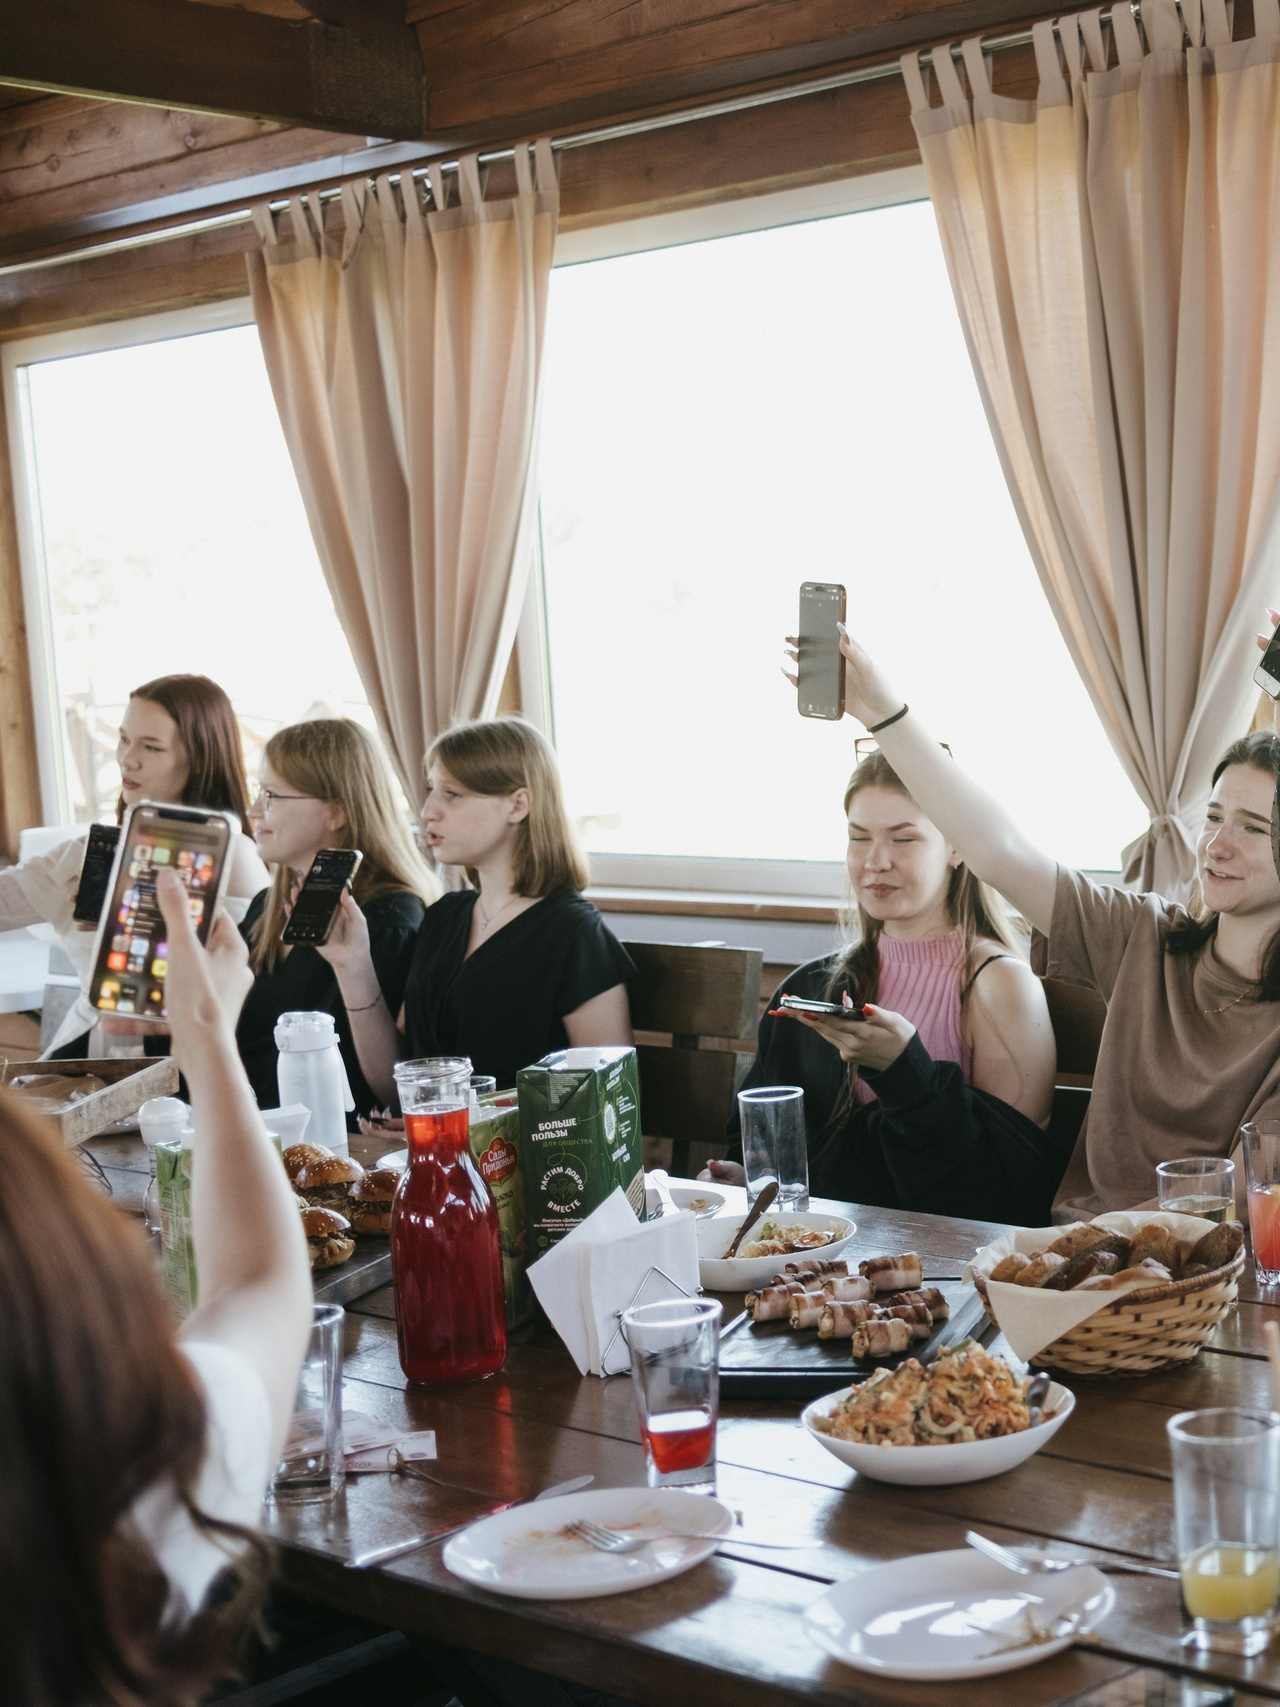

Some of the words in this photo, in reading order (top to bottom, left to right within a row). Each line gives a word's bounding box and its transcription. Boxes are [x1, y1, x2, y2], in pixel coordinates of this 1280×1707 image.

[538, 1117, 577, 1131] БОЛЬШЕ
[531, 1129, 568, 1141] ПОЛЬЗЫ
[542, 1140, 557, 1148] ДЛЯ
[557, 1138, 593, 1146] ОБЩЕСТВА
[488, 1148, 507, 1162] Сады
[482, 1154, 515, 1176] Придонья
[540, 1166, 564, 1191] РАСТИМ
[564, 1167, 585, 1191] ДОБРО
[496, 1190, 514, 1204] БЛОКО
[547, 1199, 581, 1213] ВМЕСТЕ
